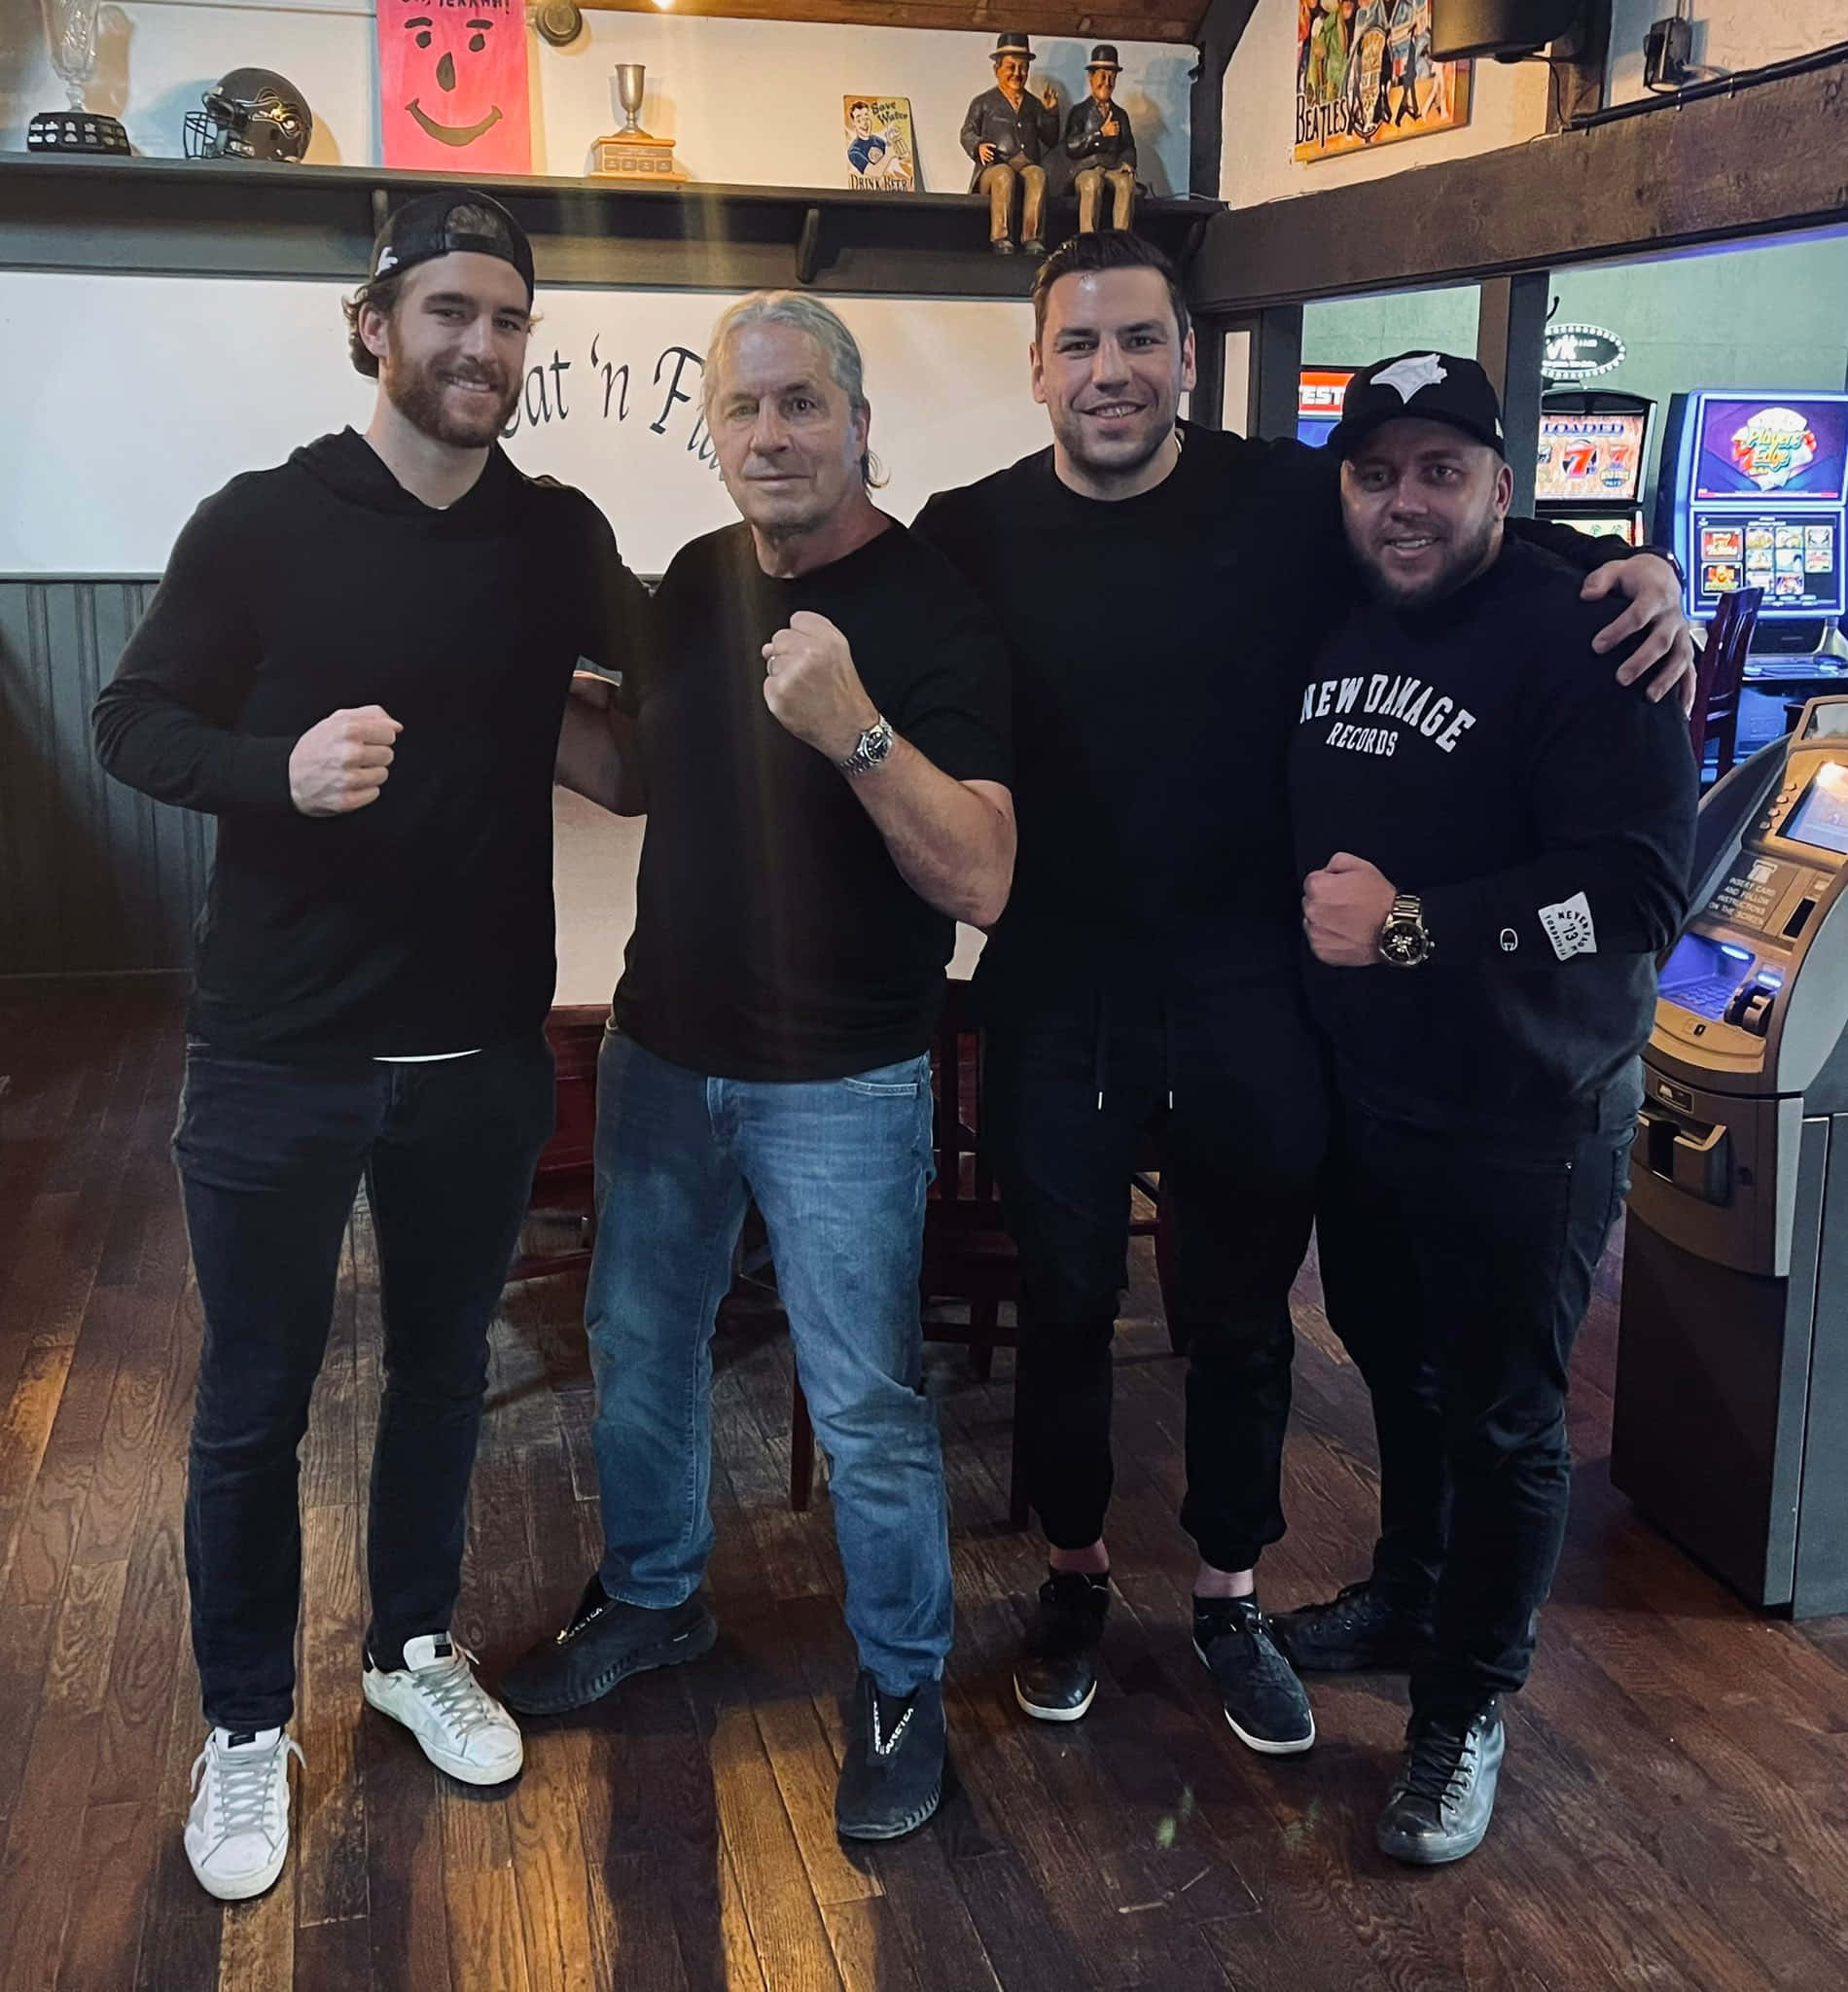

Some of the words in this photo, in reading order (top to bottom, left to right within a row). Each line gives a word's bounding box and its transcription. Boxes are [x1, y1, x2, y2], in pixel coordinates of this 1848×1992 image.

[1296, 95, 1347, 148] BEATLES
[590, 333, 630, 421] 'n
[1298, 385, 1346, 406] EST
[1544, 422, 1625, 437] LOADED
[1299, 677, 1364, 724] NEW
[1363, 674, 1477, 753] DAMAGE
[1326, 722, 1399, 757] RECORDS
